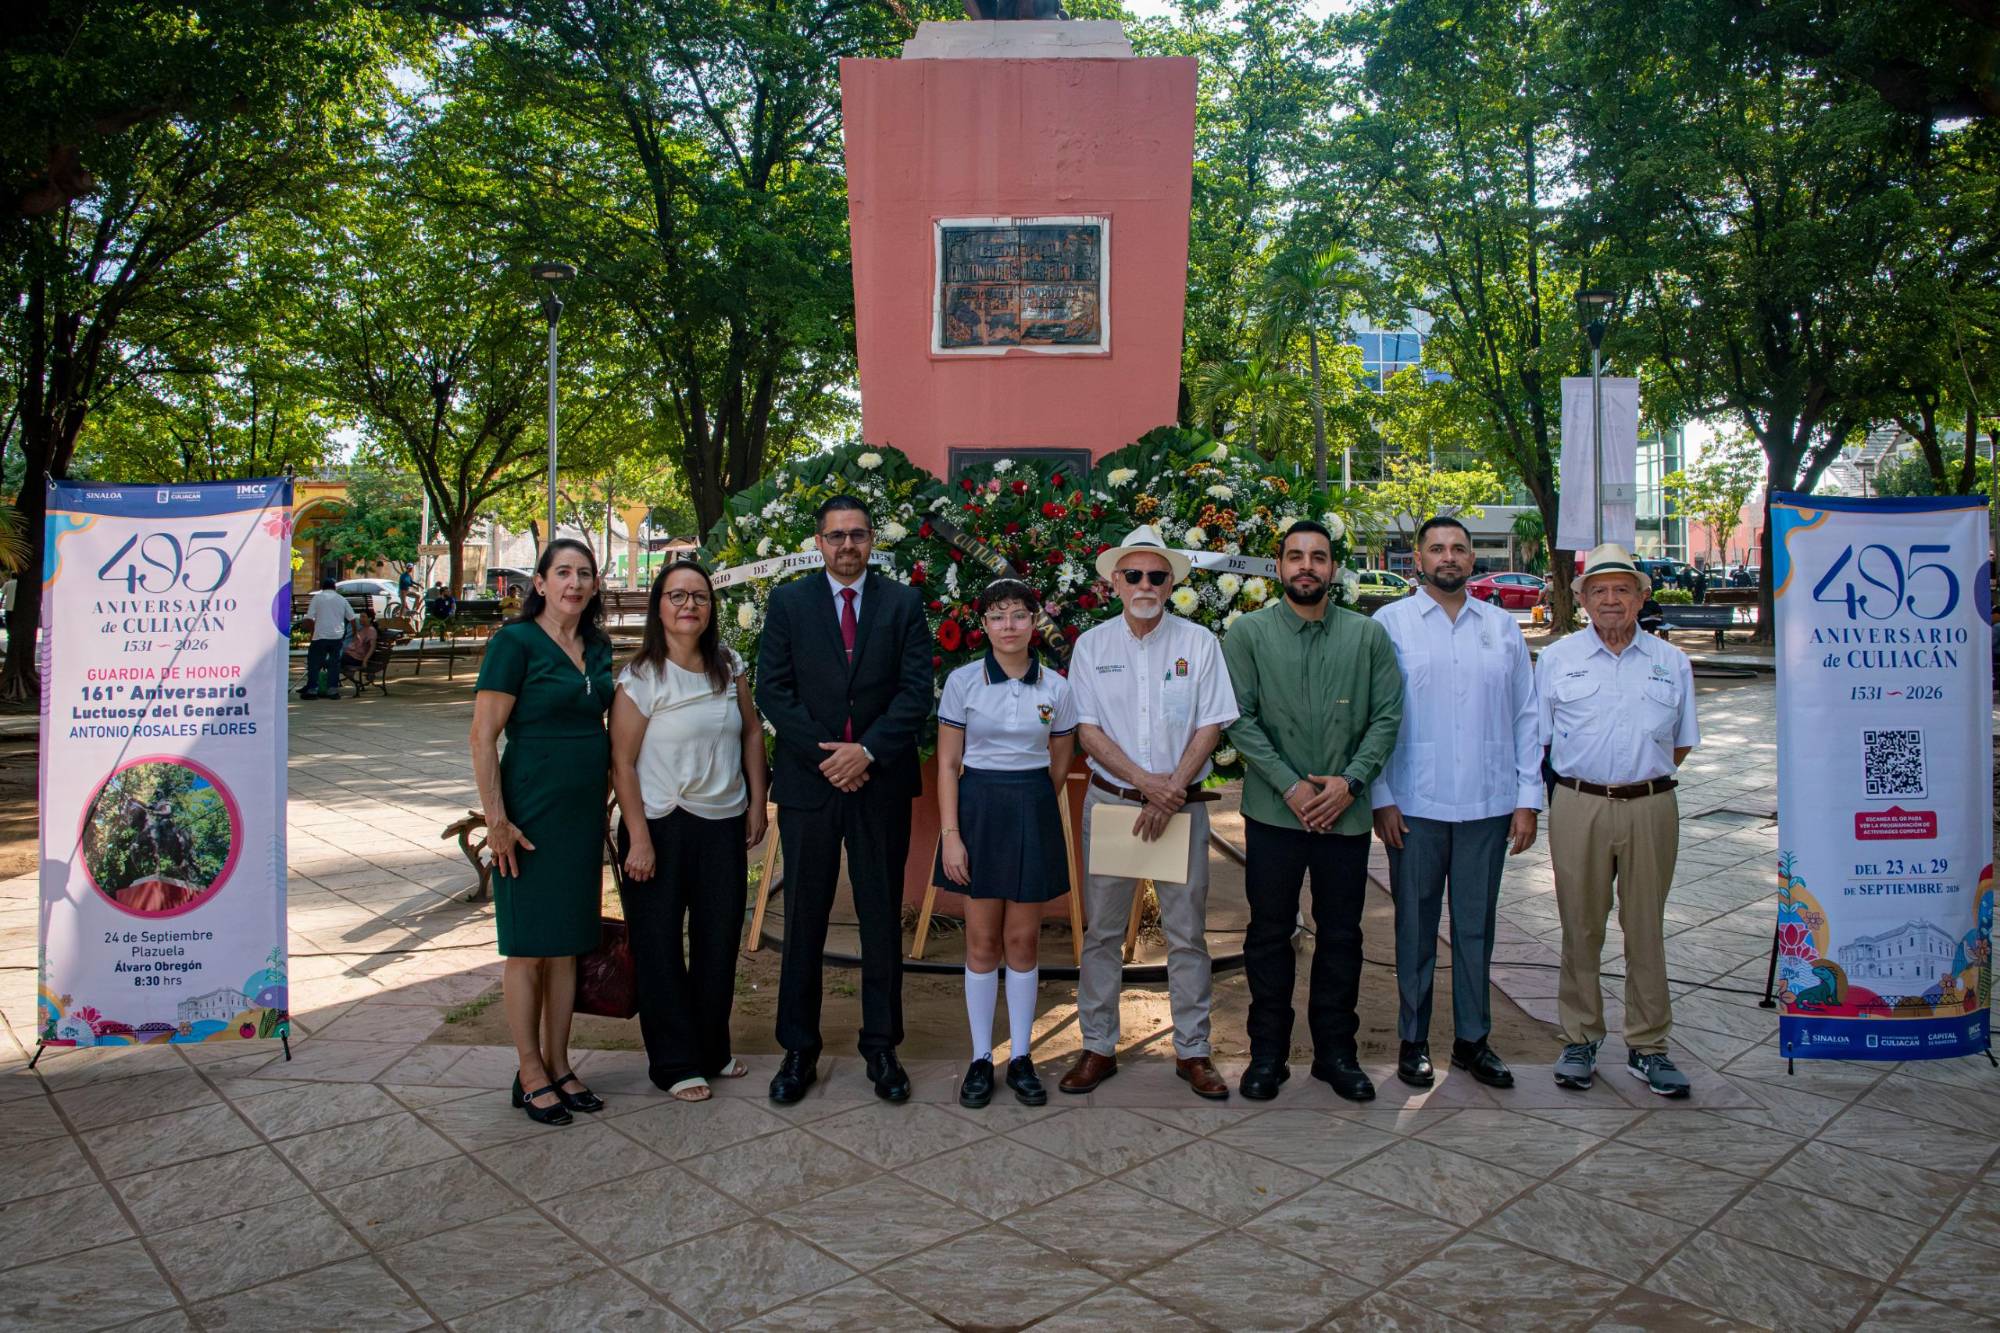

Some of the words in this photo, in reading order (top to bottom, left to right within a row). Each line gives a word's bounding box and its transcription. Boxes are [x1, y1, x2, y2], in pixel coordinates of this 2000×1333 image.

[86, 492, 122, 500] SINALOA
[236, 485, 267, 495] IMCC
[954, 533, 1008, 576] CULTURA
[97, 531, 233, 594] 495
[753, 564, 768, 575] DE
[1229, 559, 1246, 569] DE
[1813, 544, 1960, 620] 495
[92, 598, 237, 614] ANIVERSARIO
[101, 621, 118, 634] de
[123, 613, 225, 634] CULIACÁN
[1809, 628, 1968, 644] ANIVERSARIO
[123, 640, 153, 652] 1531
[174, 639, 209, 652] 2026
[1823, 653, 1841, 668] de
[1847, 645, 1958, 669] CULIACÁN
[87, 668, 155, 680] GUARDIA
[161, 667, 180, 679] DE
[186, 666, 241, 678] HONOR
[81, 686, 124, 701] 161°
[130, 684, 248, 700] Aniversario
[1850, 686, 1882, 700] 1531
[1906, 685, 1943, 700] 2026
[72, 705, 146, 720] Luctuoso
[152, 704, 179, 718] del
[184, 702, 250, 717] General
[69, 725, 129, 739] ANTONIO
[133, 723, 197, 737] ROSALES
[201, 722, 257, 736] FLORES
[1855, 865, 1881, 875] DEL
[1886, 860, 1904, 875] 23
[1909, 864, 1926, 874] AL
[1930, 859, 1948, 873] 29
[1844, 888, 1856, 896] DE
[1859, 883, 1943, 896] SEPTIEMBRE
[104, 932, 119, 944] 24
[123, 931, 138, 943] de
[141, 929, 213, 944] Septiembre
[132, 945, 185, 957] Plazuela
[114, 960, 152, 973] Álvaro
[155, 960, 202, 974] Obregón
[134, 976, 160, 986] 8:30
[163, 975, 182, 986] hrs
[1812, 1034, 1850, 1043] SINALOA
[1928, 1032, 1957, 1040] CAPITAL
